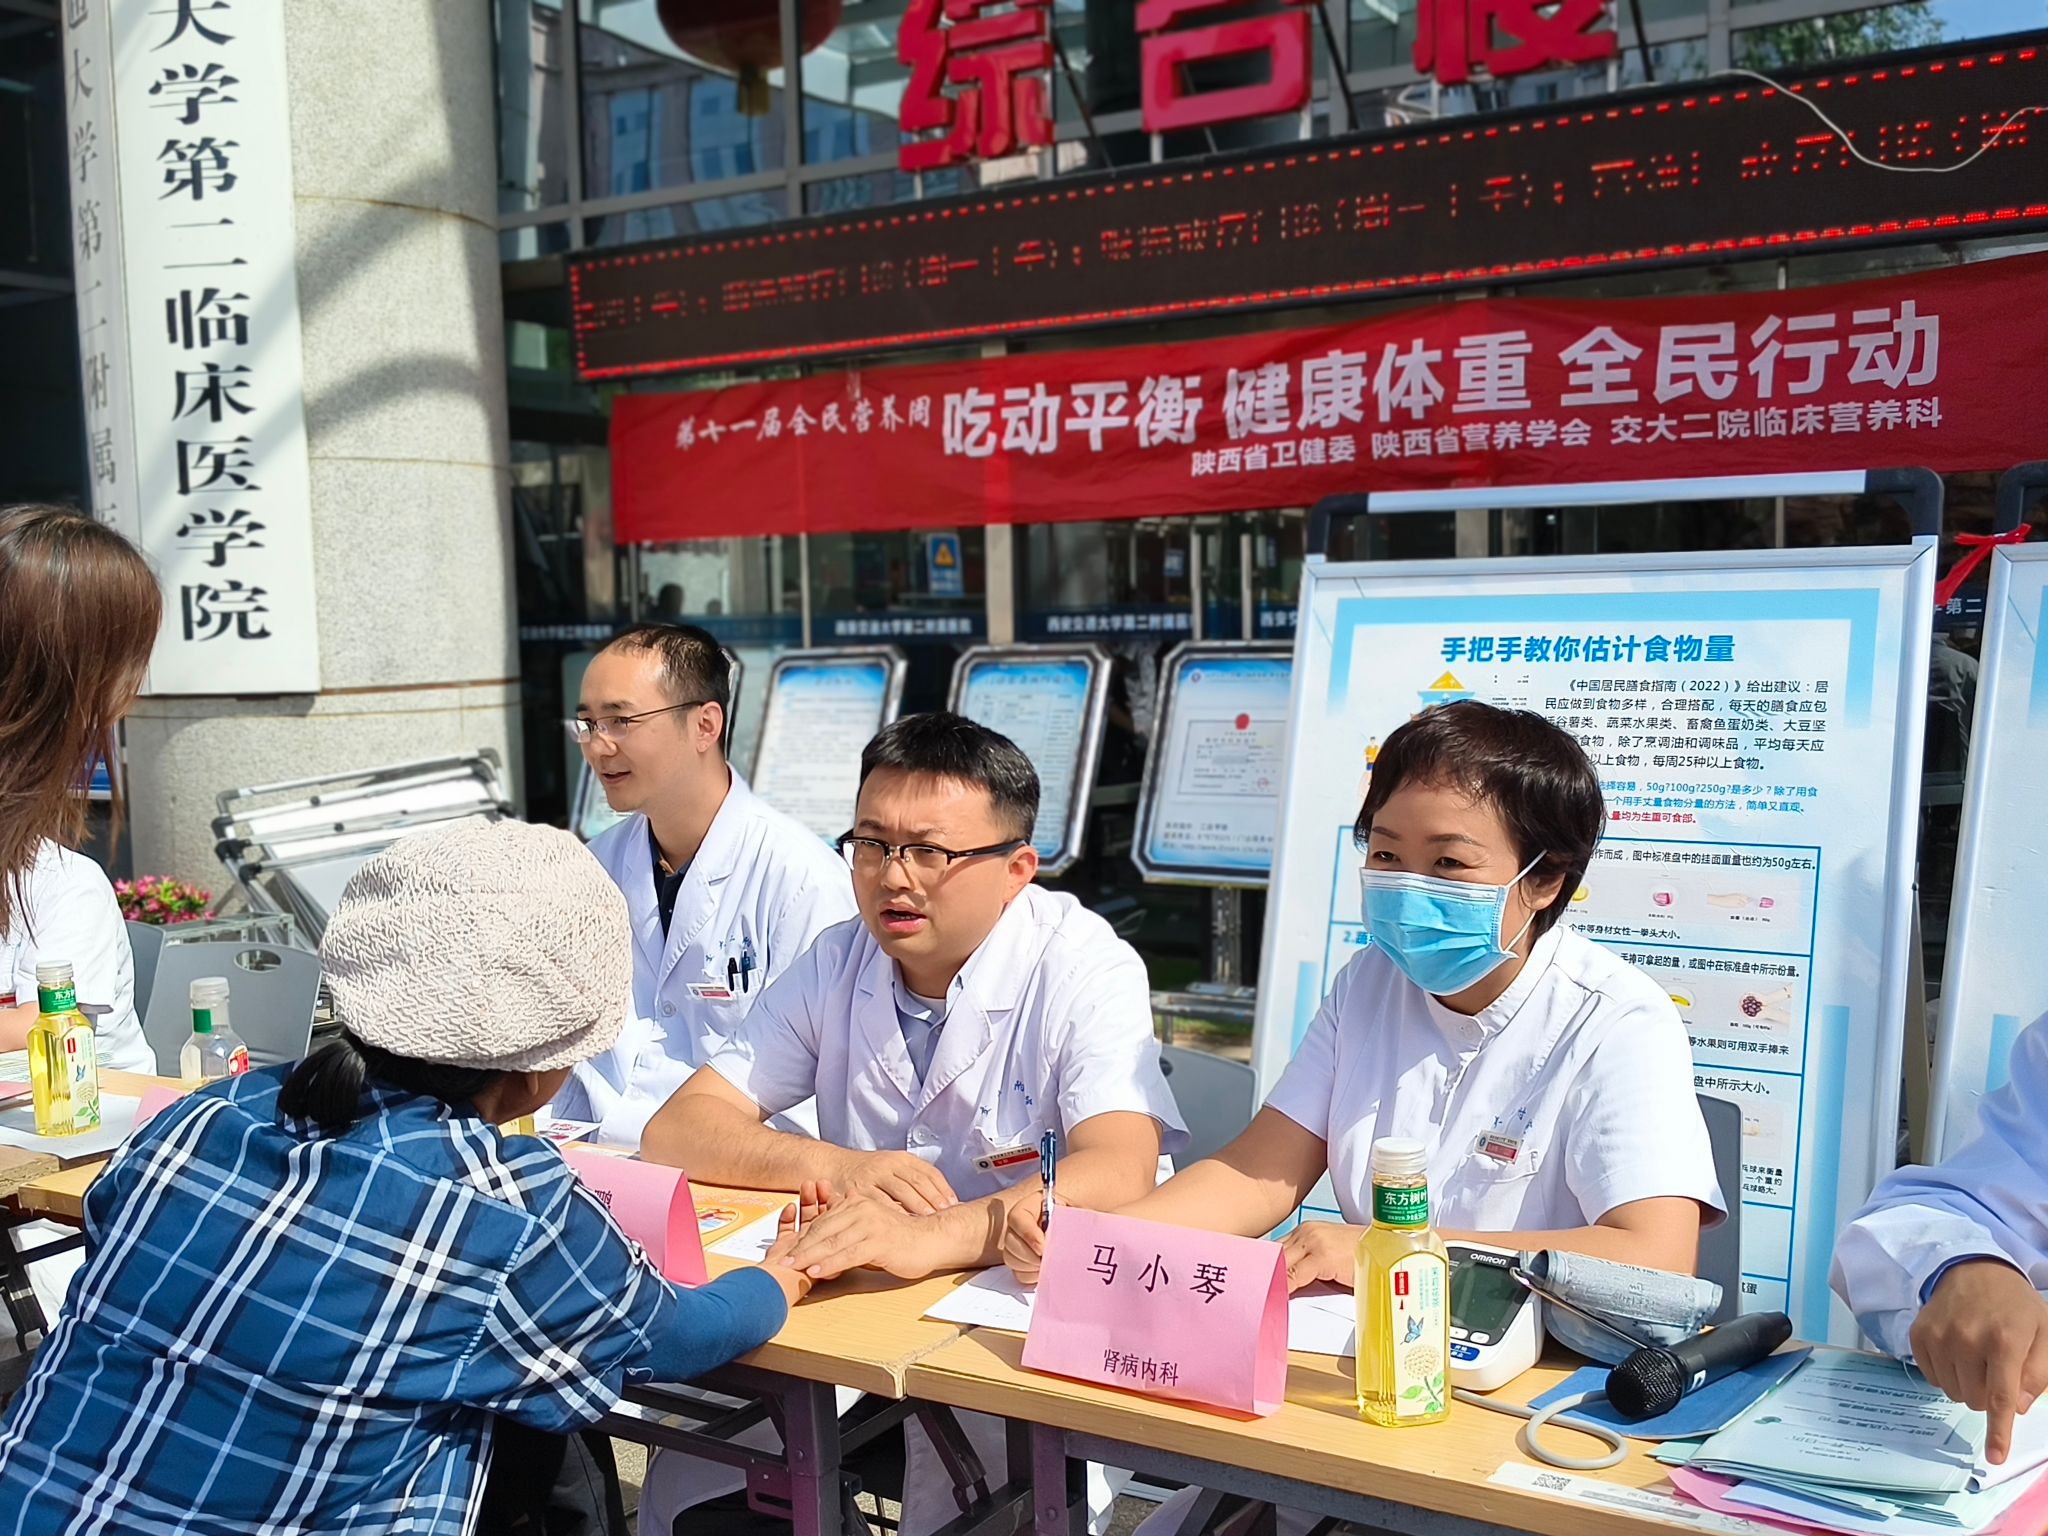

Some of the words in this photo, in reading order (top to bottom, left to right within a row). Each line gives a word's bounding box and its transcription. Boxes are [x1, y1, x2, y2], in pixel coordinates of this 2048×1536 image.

[147, 0, 271, 641] 大学第二临床医学院
[675, 395, 931, 451] 第十一届全民营养周
[943, 376, 1204, 458] 吃动平衡
[1222, 330, 1534, 442] 健康体重
[1558, 300, 1940, 407] 全民行动
[1191, 435, 1356, 477] 陕西省卫健委
[1371, 419, 1592, 459] 陕西省营养学会
[1610, 396, 1943, 445] 交大二院临床营养科
[1934, 597, 1982, 615] 第二
[1440, 634, 1736, 663] 手把手教你估计食物量
[1575, 735, 1824, 752] 食物，除了烹调油和调味品，平均每天应
[1588, 754, 1765, 770] 以上食物，每周25种以上食物。
[1087, 1244, 1228, 1304] 马小琴
[1470, 1253, 1507, 1265] OMRON
[1103, 1349, 1179, 1387] 肾病内科
